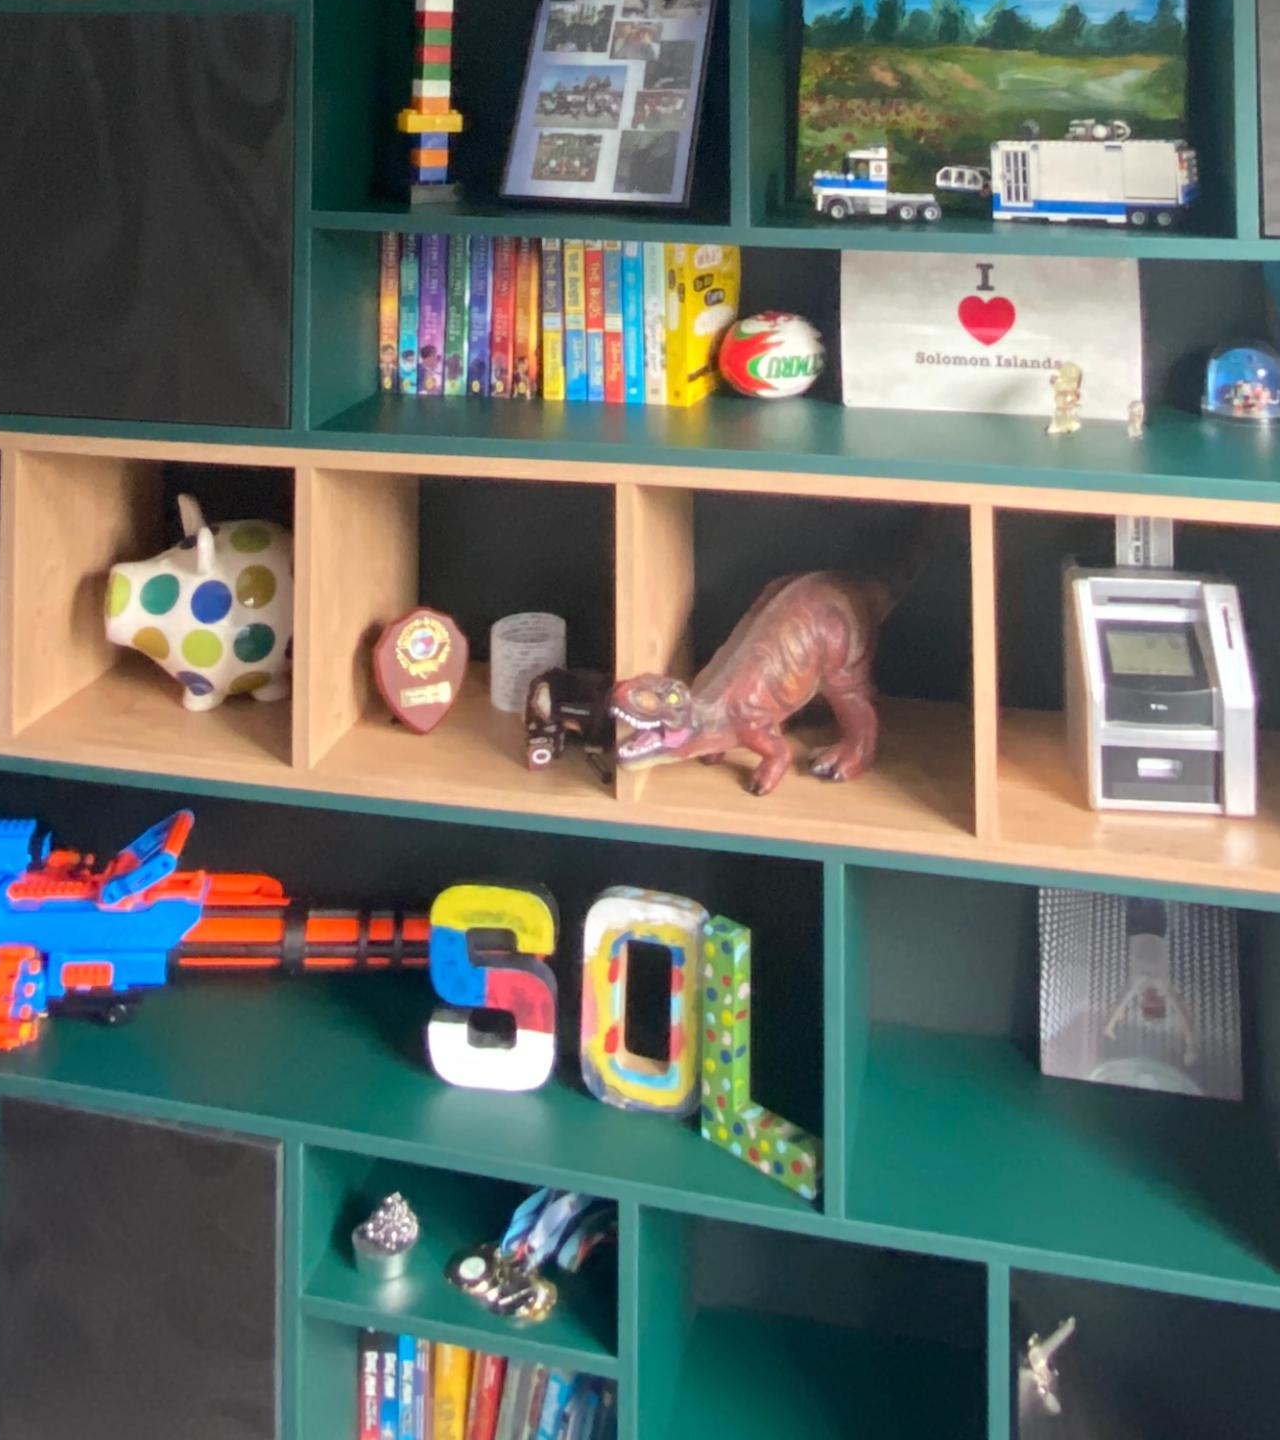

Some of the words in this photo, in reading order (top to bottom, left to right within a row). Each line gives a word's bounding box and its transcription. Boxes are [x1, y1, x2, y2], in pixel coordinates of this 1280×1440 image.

[976, 263, 995, 291] I
[915, 351, 990, 368] Solomon
[995, 354, 1061, 370] Islands
